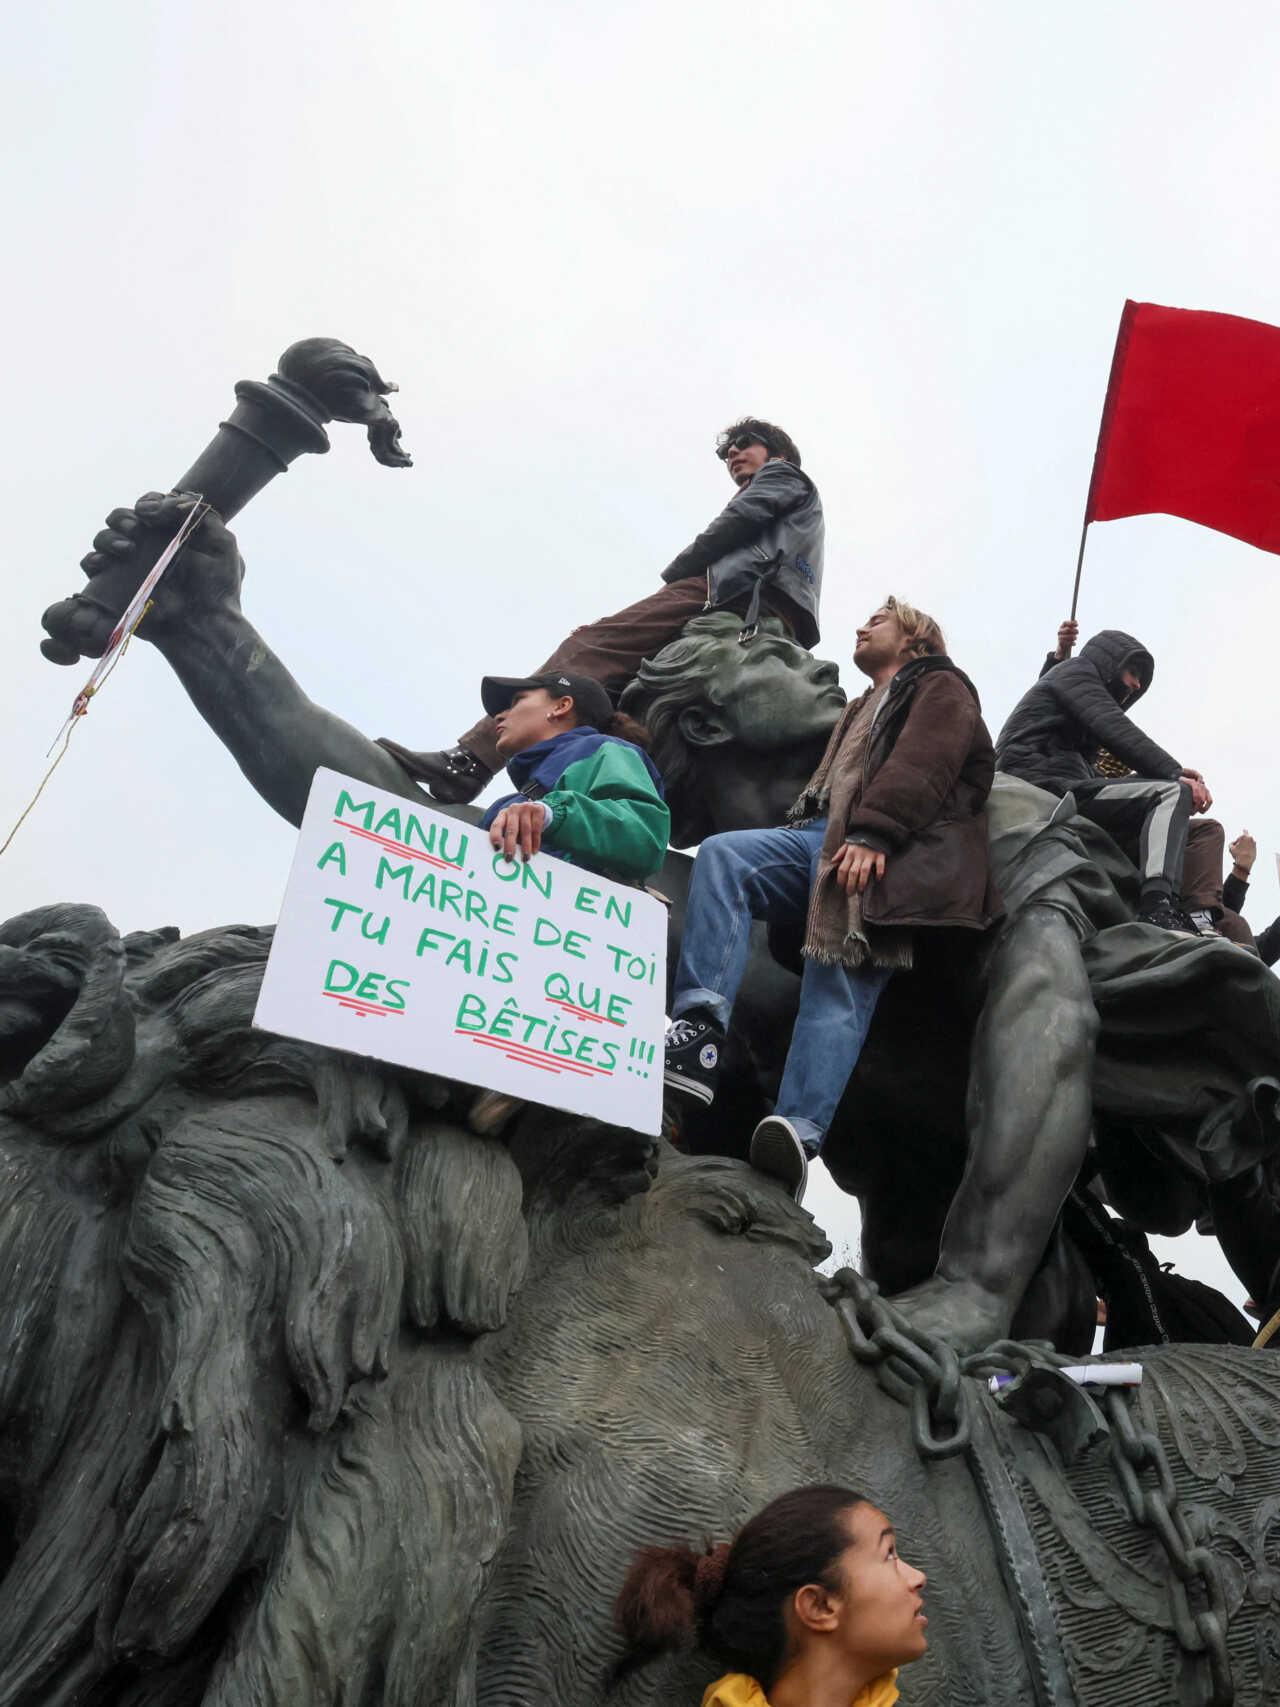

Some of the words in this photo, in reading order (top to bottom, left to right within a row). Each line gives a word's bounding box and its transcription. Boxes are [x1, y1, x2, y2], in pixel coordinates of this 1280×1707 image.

[317, 841, 347, 876] A
[376, 856, 520, 936] MARRE
[534, 918, 592, 960] DE
[334, 790, 475, 879] MANU,
[492, 853, 552, 899] ON
[574, 888, 632, 928] EN
[324, 898, 391, 944] TU
[544, 972, 633, 1024] QUE
[324, 960, 411, 1008] DES
